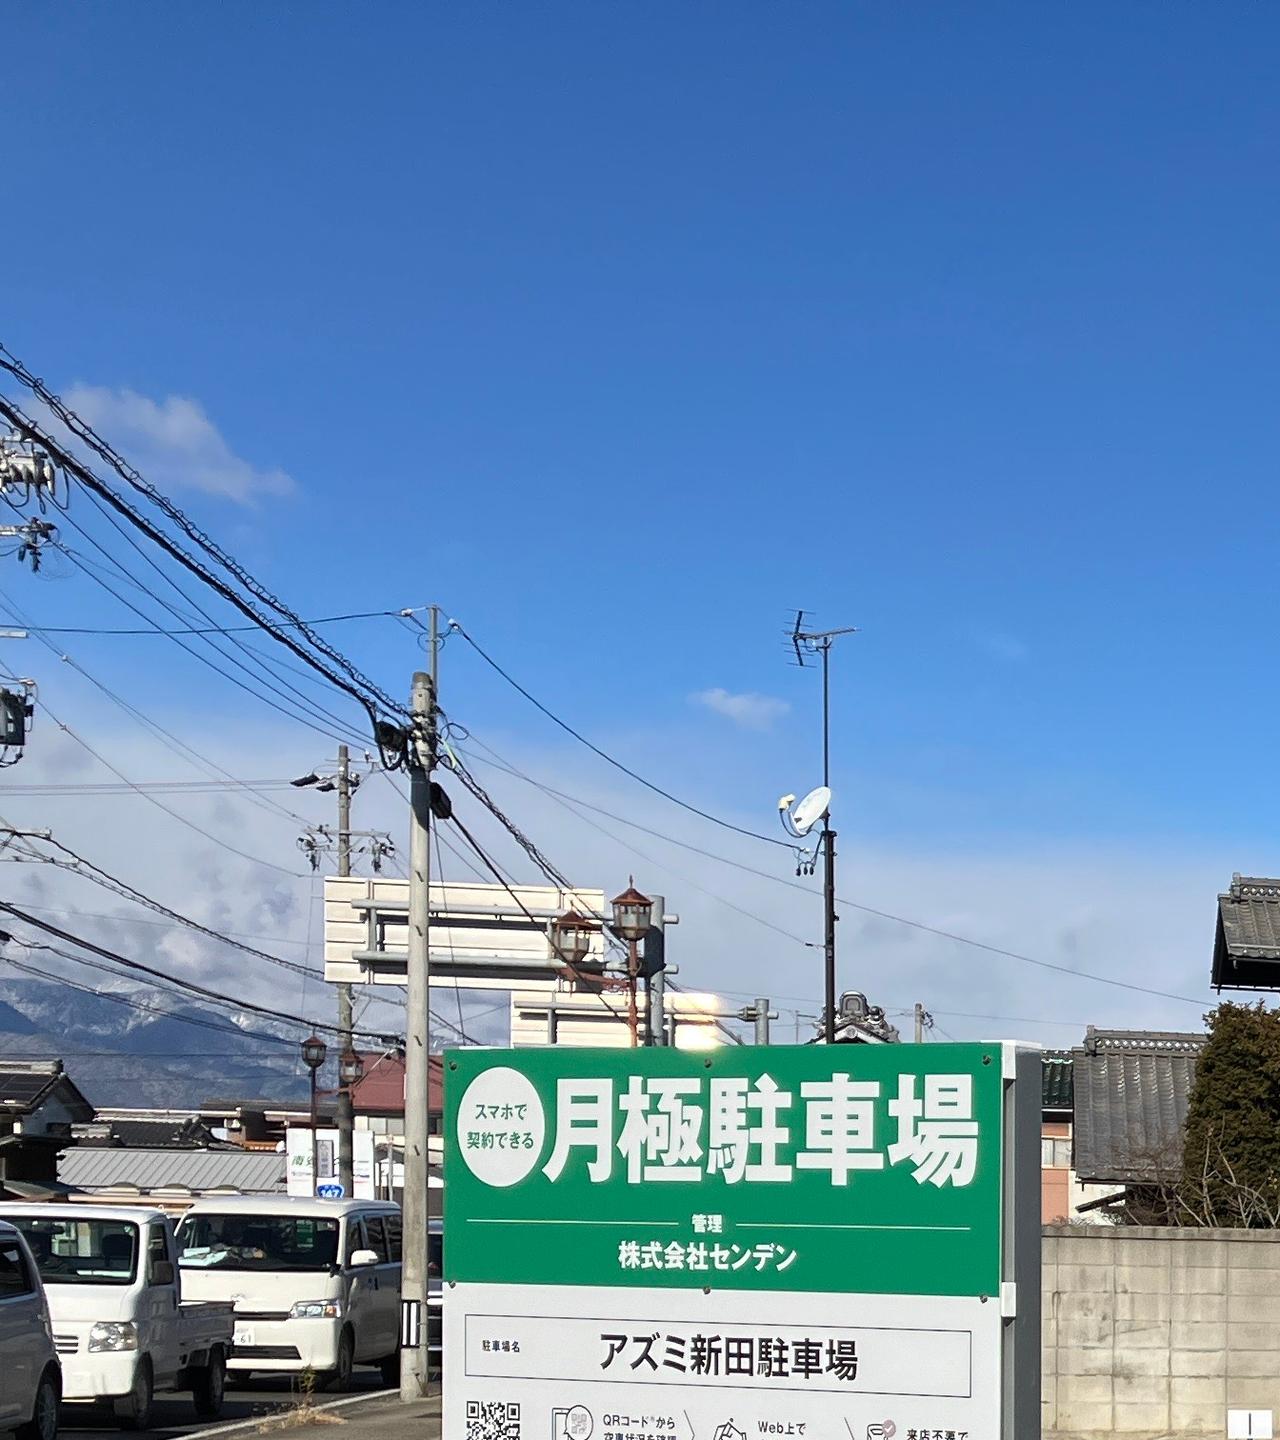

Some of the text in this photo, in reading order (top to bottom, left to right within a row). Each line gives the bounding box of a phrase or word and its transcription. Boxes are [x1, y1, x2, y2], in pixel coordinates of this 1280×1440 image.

[475, 1103, 528, 1121] スマホで
[542, 1072, 979, 1188] 月極駐車場
[466, 1131, 534, 1150] 契約できる
[691, 1214, 723, 1233] 管理
[617, 1240, 797, 1272] 株式会社センデン
[482, 1339, 520, 1353] 駐車場名
[599, 1332, 859, 1382] アズミ新田駐車場
[757, 1420, 807, 1436] Web上で
